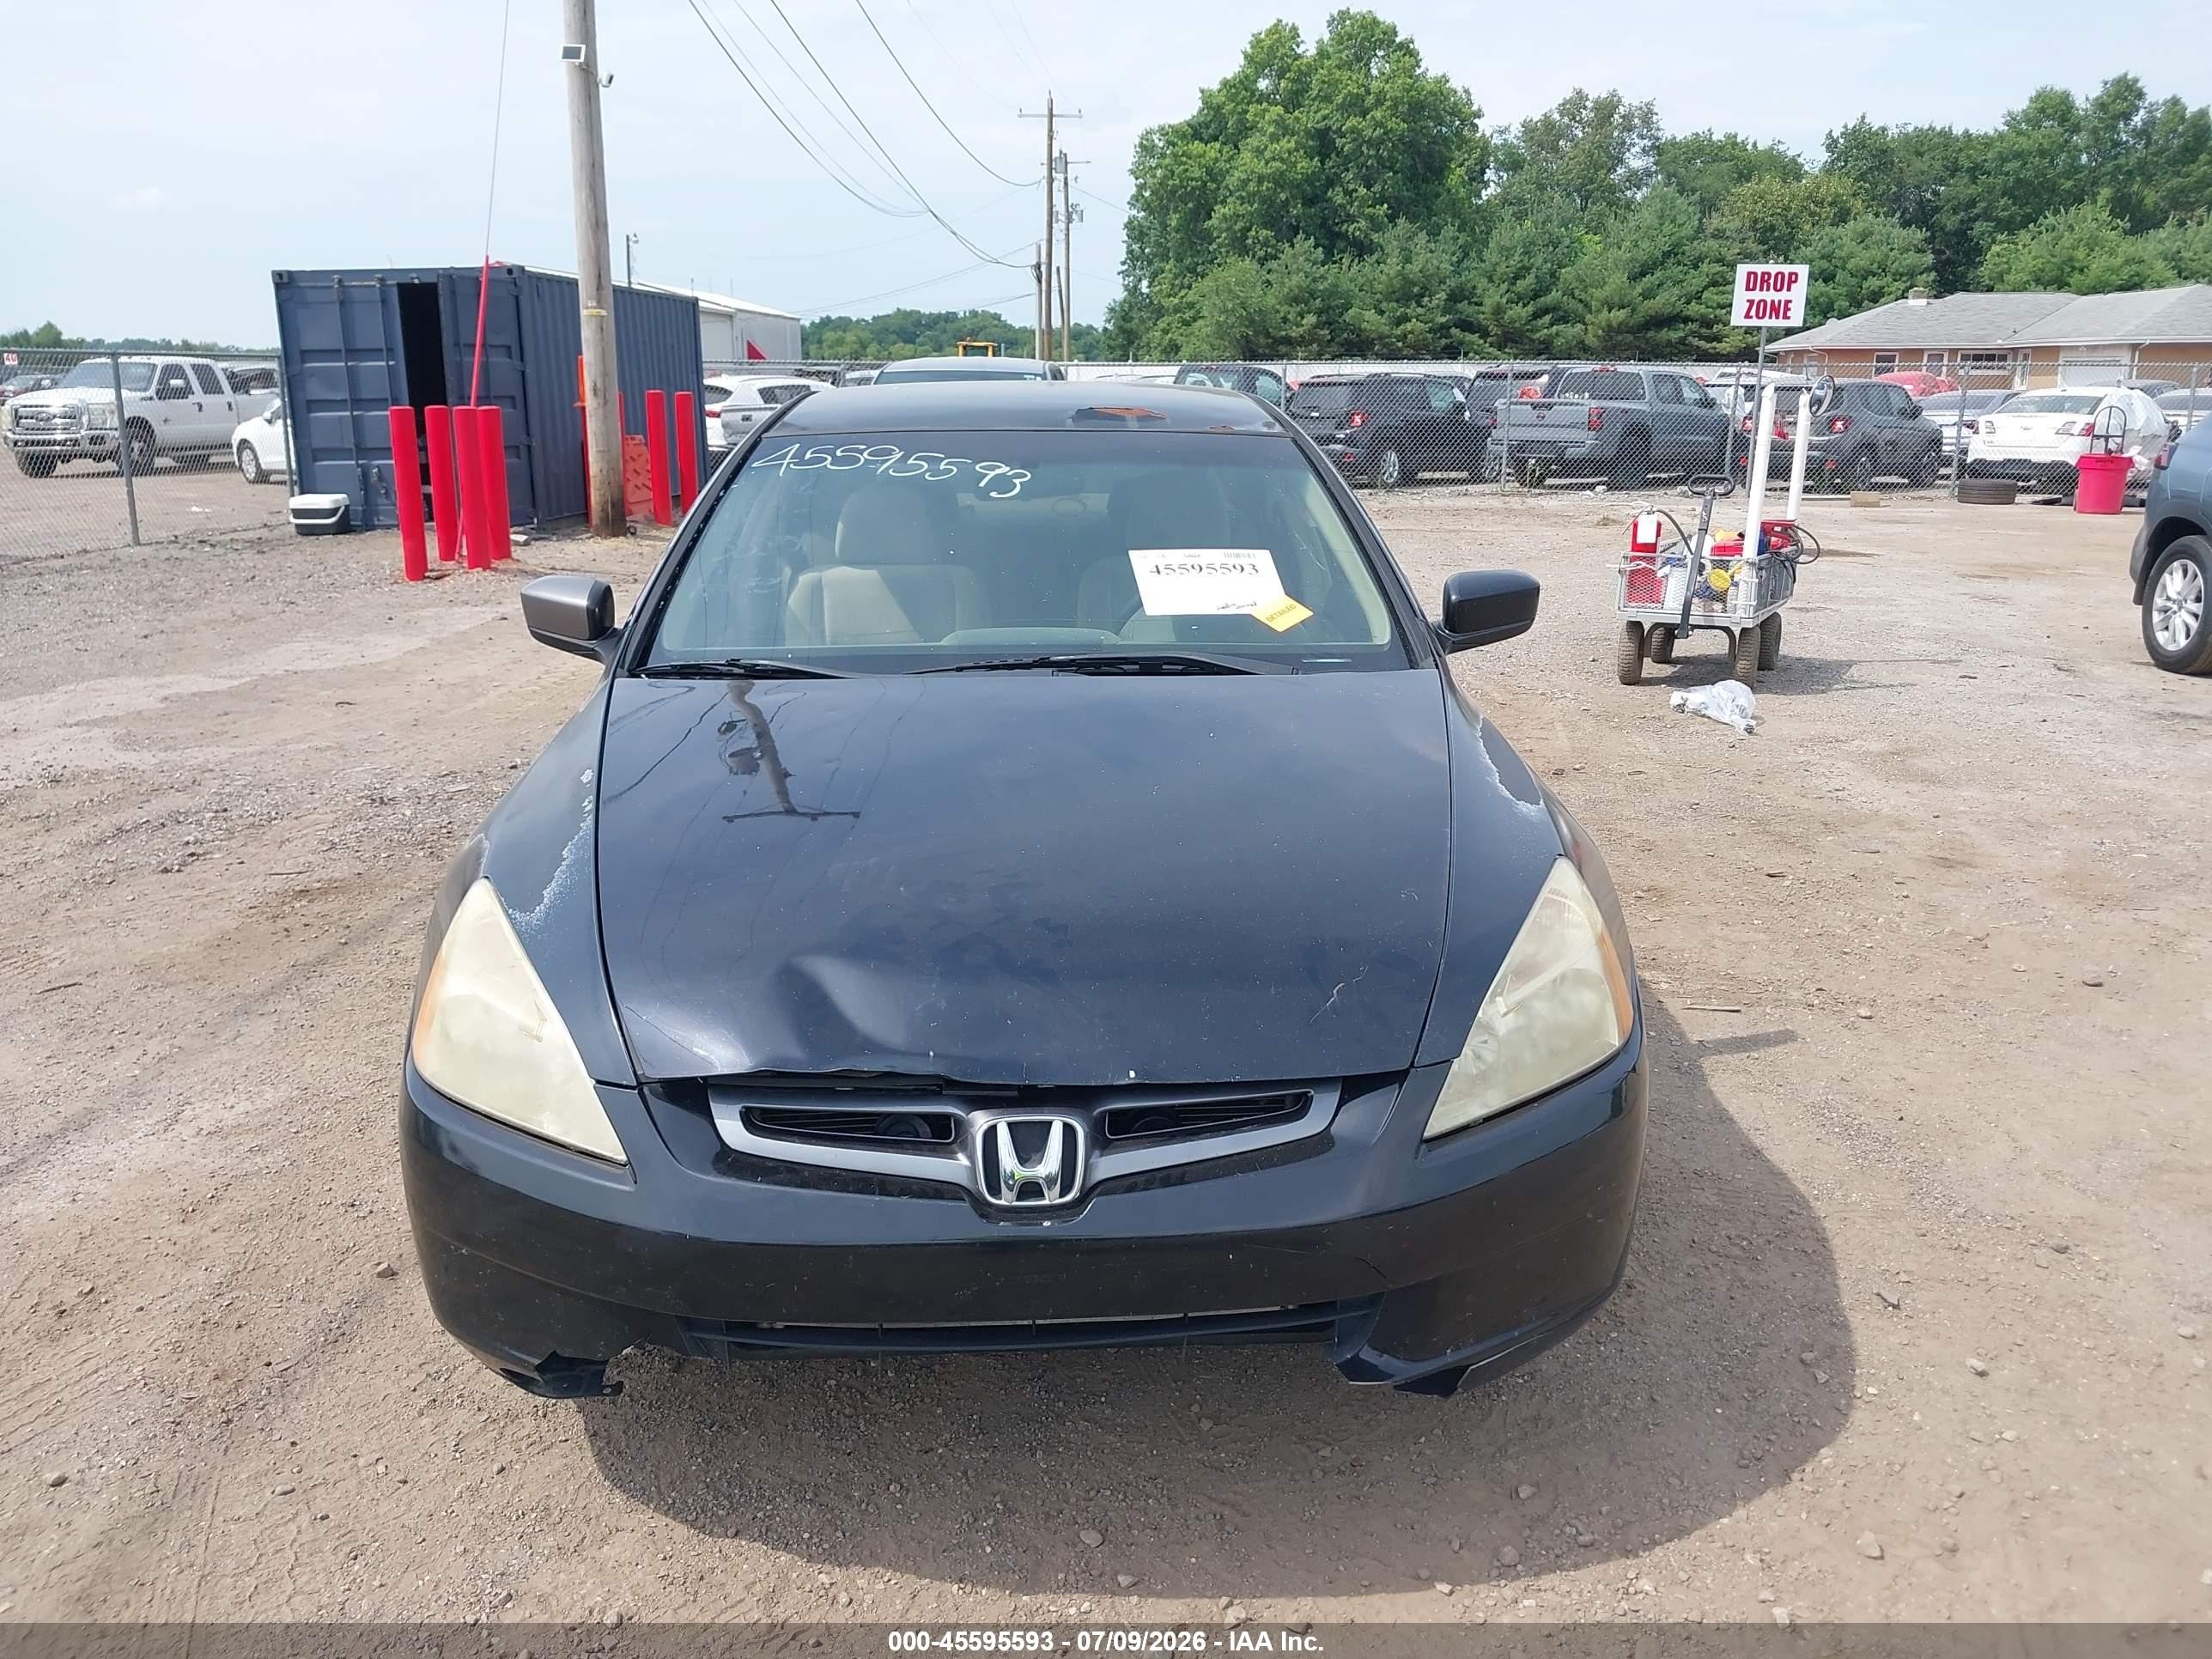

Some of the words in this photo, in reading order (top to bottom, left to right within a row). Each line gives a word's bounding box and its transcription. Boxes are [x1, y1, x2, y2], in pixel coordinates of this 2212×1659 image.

[1745, 270, 1799, 293] DROP
[1744, 298, 1793, 320] ZONE
[750, 442, 1032, 499] 45595593
[1149, 562, 1260, 576] 45595593
[1266, 604, 1297, 623] DETAILED
